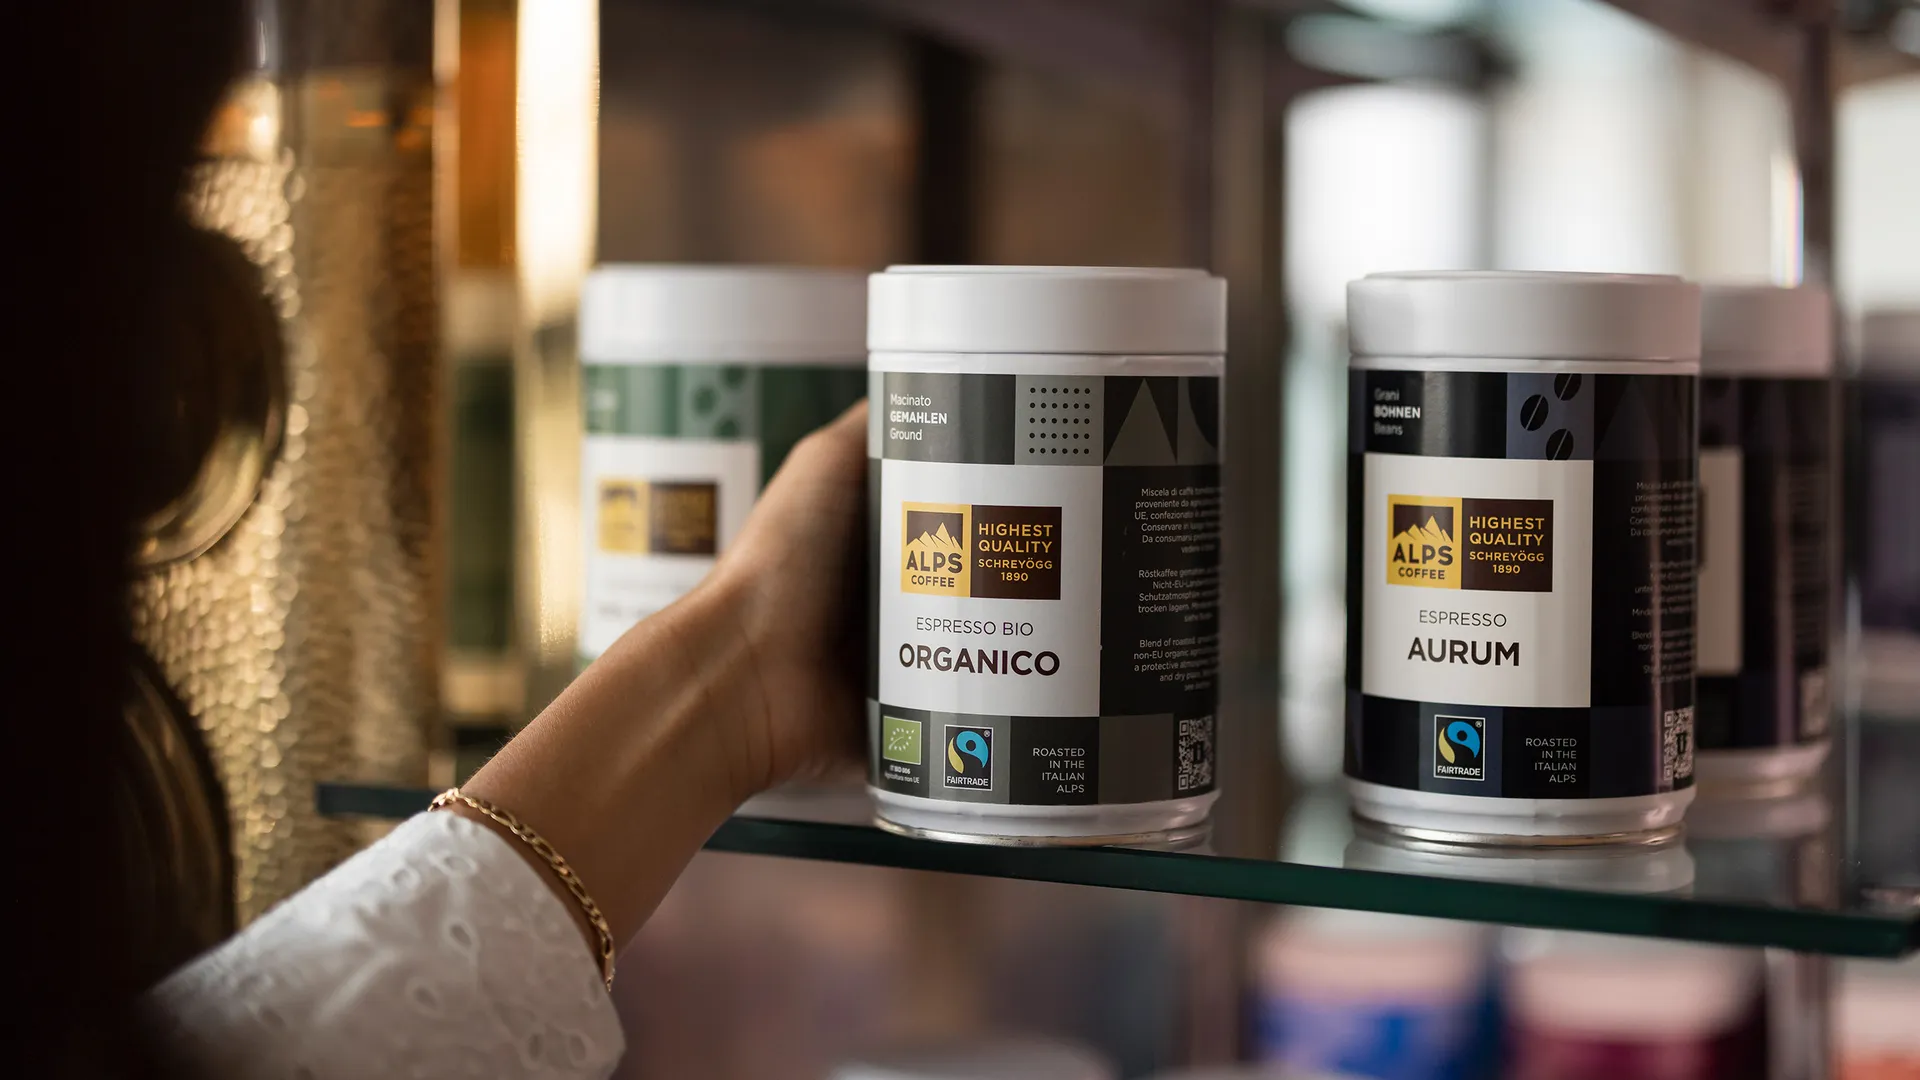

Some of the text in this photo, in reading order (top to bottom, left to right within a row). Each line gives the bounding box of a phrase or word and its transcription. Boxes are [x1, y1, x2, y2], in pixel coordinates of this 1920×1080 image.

[890, 393, 931, 407] Macinato
[1374, 406, 1421, 418] BOHNEN
[890, 410, 948, 425] GEMAHLEN
[890, 427, 922, 441] Ground
[1141, 488, 1169, 496] Miscela
[1171, 488, 1177, 496] di
[1135, 500, 1179, 509] proveniente
[1134, 511, 1148, 520] UE,
[1141, 523, 1182, 532] Conservare
[1470, 516, 1545, 530] HIGHEST
[978, 523, 1053, 538] HIGHEST
[1142, 534, 1153, 543] Da
[1470, 533, 1544, 547] QUALITY
[978, 539, 1053, 554] QUALITY
[1393, 543, 1453, 565] ALPS
[1469, 550, 1545, 562] SCHREYÖGG
[906, 550, 963, 574] ALPS
[978, 556, 1053, 570] SCHREYÖGG
[1138, 569, 1178, 578] Röstkaffee
[1398, 567, 1445, 580] COFFEE
[1492, 564, 1521, 574] 1890
[911, 575, 955, 588] COFFEE
[1000, 572, 1029, 582] 1890
[1138, 604, 1167, 613] trocken
[1419, 610, 1507, 627] ESPRESSO
[916, 617, 1034, 636] ESPRESSO BIO
[1139, 639, 1162, 648] Blend
[1164, 638, 1171, 646] of
[1133, 651, 1163, 660] non-EU
[1408, 637, 1519, 666] AURUM
[899, 643, 1061, 676] ORGANICO
[1134, 664, 1140, 672] a
[1141, 662, 1178, 672] protective
[1174, 672, 1185, 681] dry
[1525, 738, 1577, 747] ROASTED
[1033, 748, 1085, 758] ROASTED
[1556, 751, 1577, 759] THE
[1049, 760, 1085, 769] IN THE
[1534, 763, 1577, 771] ITALIAN
[1437, 765, 1480, 777] FAIRTRADE
[946, 775, 989, 787] FAIRTRADE
[1041, 772, 1085, 781] ITALIAN
[1549, 774, 1577, 783] ALPS
[1057, 784, 1085, 794] ALPS
